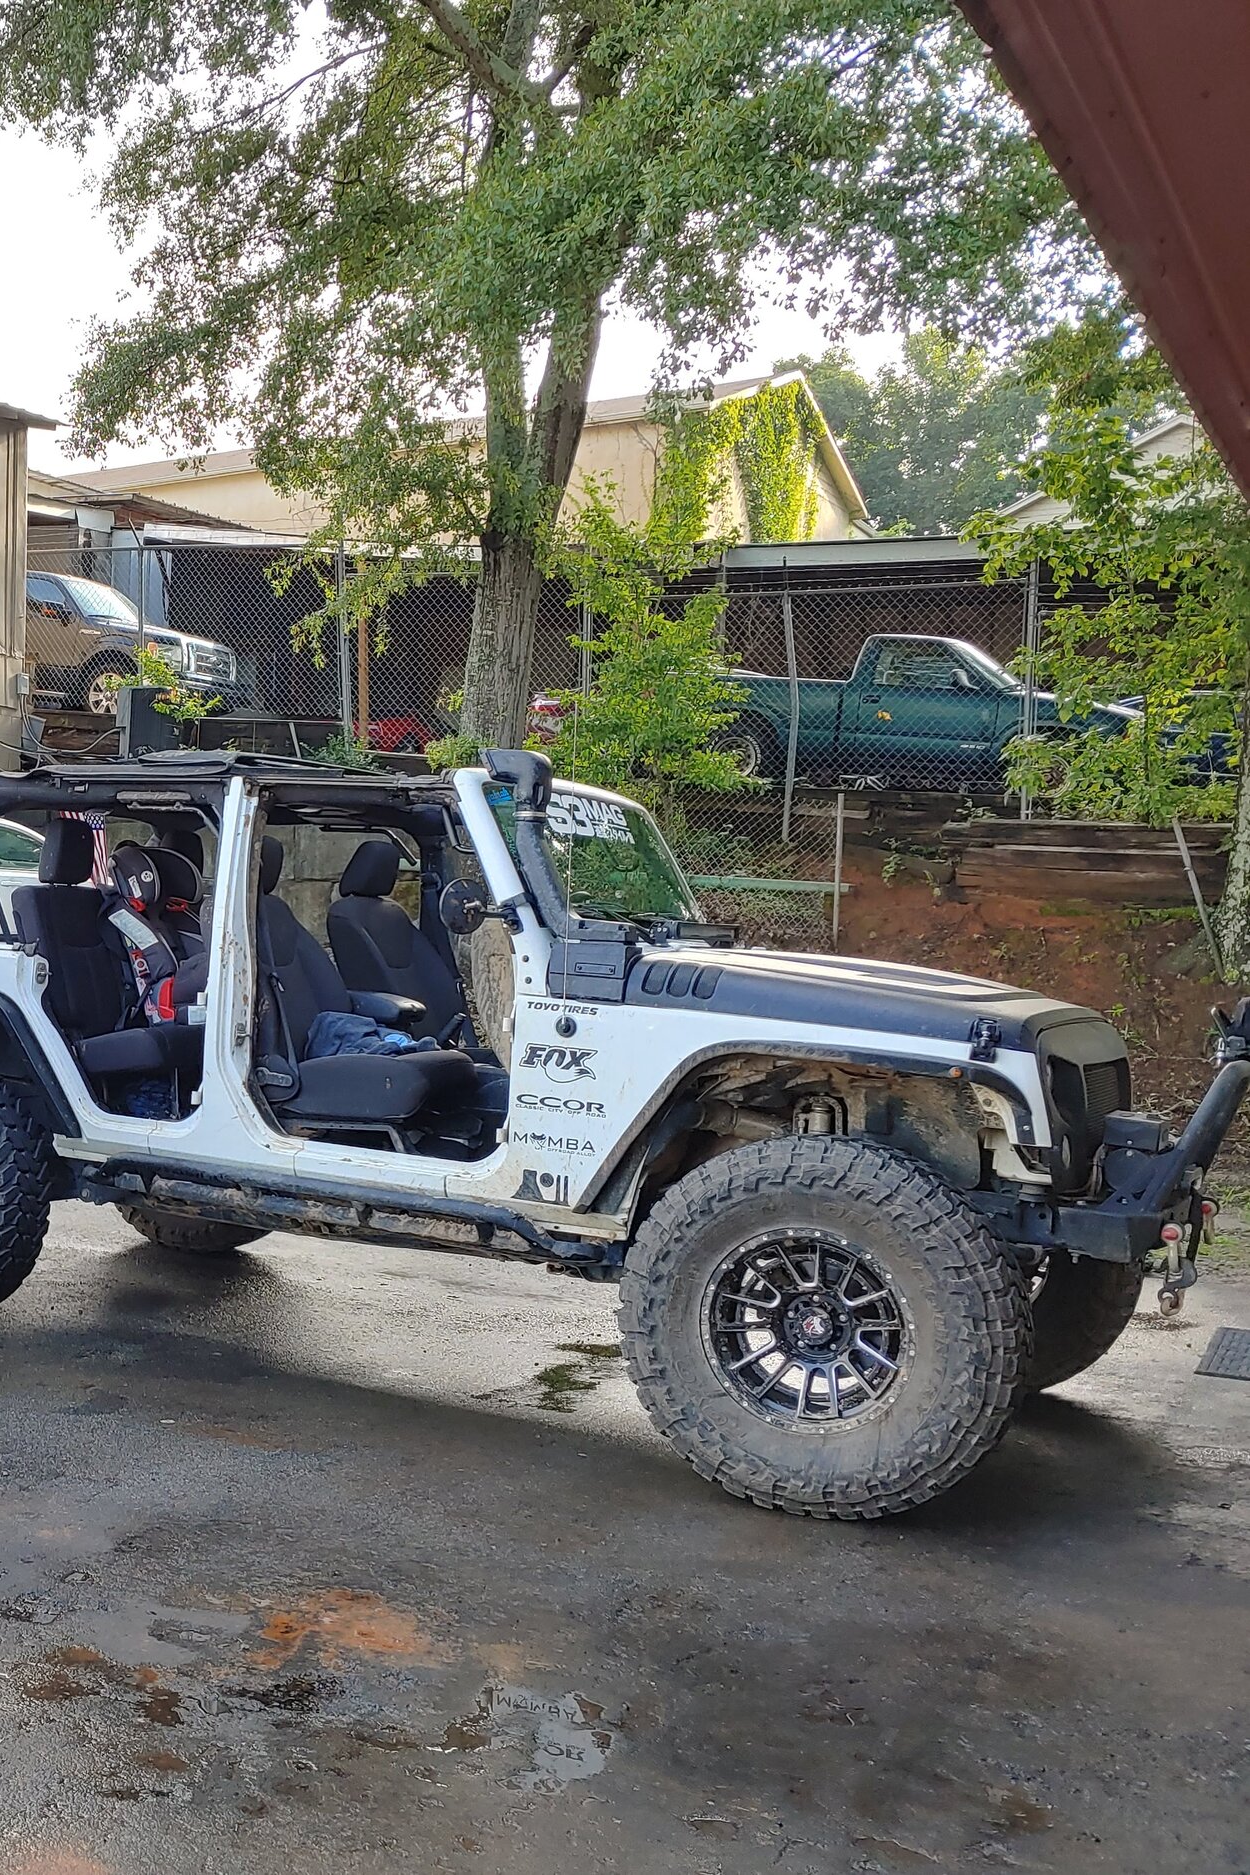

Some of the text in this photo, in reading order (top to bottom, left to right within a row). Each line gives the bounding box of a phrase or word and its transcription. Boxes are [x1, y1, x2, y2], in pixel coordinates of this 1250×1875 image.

[581, 798, 628, 826] MAG
[521, 1045, 596, 1072] FOX
[515, 1103, 544, 1111] CLASSIC
[516, 1094, 606, 1114] CCOR
